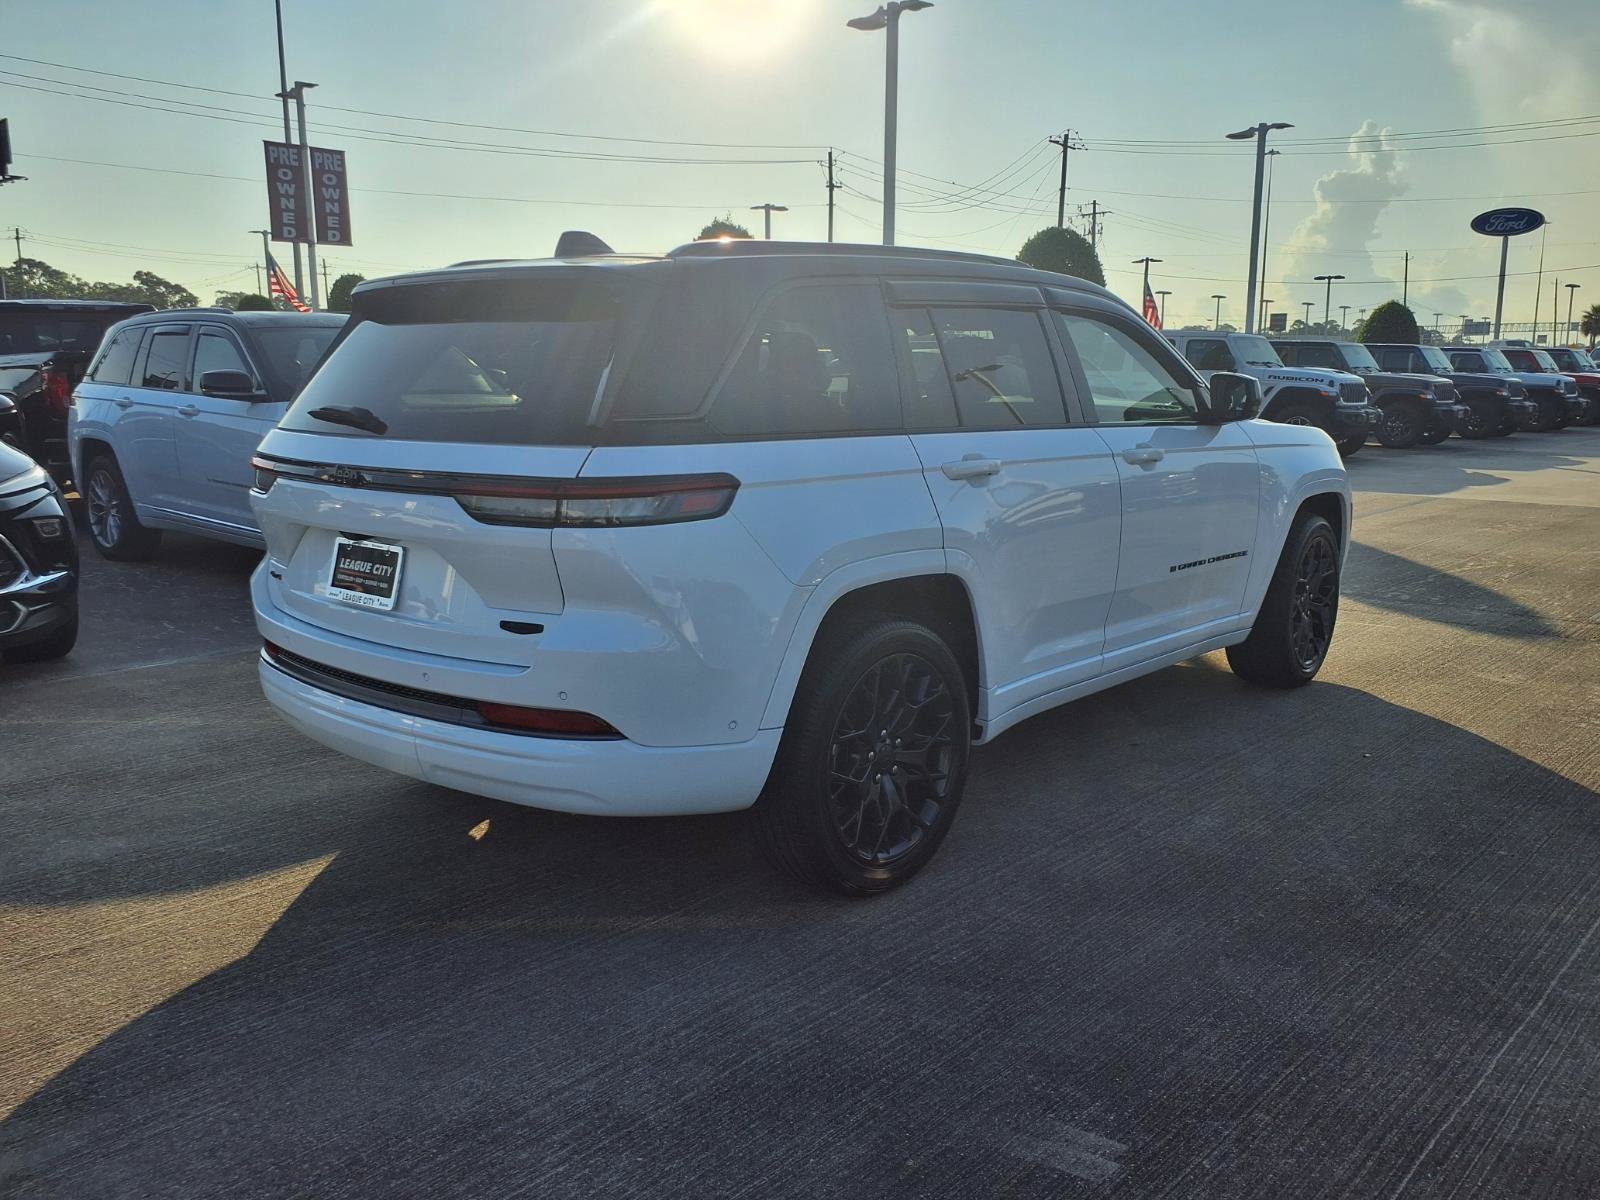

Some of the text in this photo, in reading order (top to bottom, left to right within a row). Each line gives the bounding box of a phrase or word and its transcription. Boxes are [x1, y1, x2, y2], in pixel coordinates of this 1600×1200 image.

[268, 146, 299, 167] PRE
[313, 152, 343, 172] PRE
[276, 168, 297, 239] OWNED
[321, 173, 341, 242] OWNED
[1485, 213, 1529, 232] Ford
[1267, 374, 1325, 383] RUBICON
[340, 557, 394, 577] LEAGUE CITY
[342, 592, 363, 605] LEAGUE
[362, 597, 376, 607] CITY
